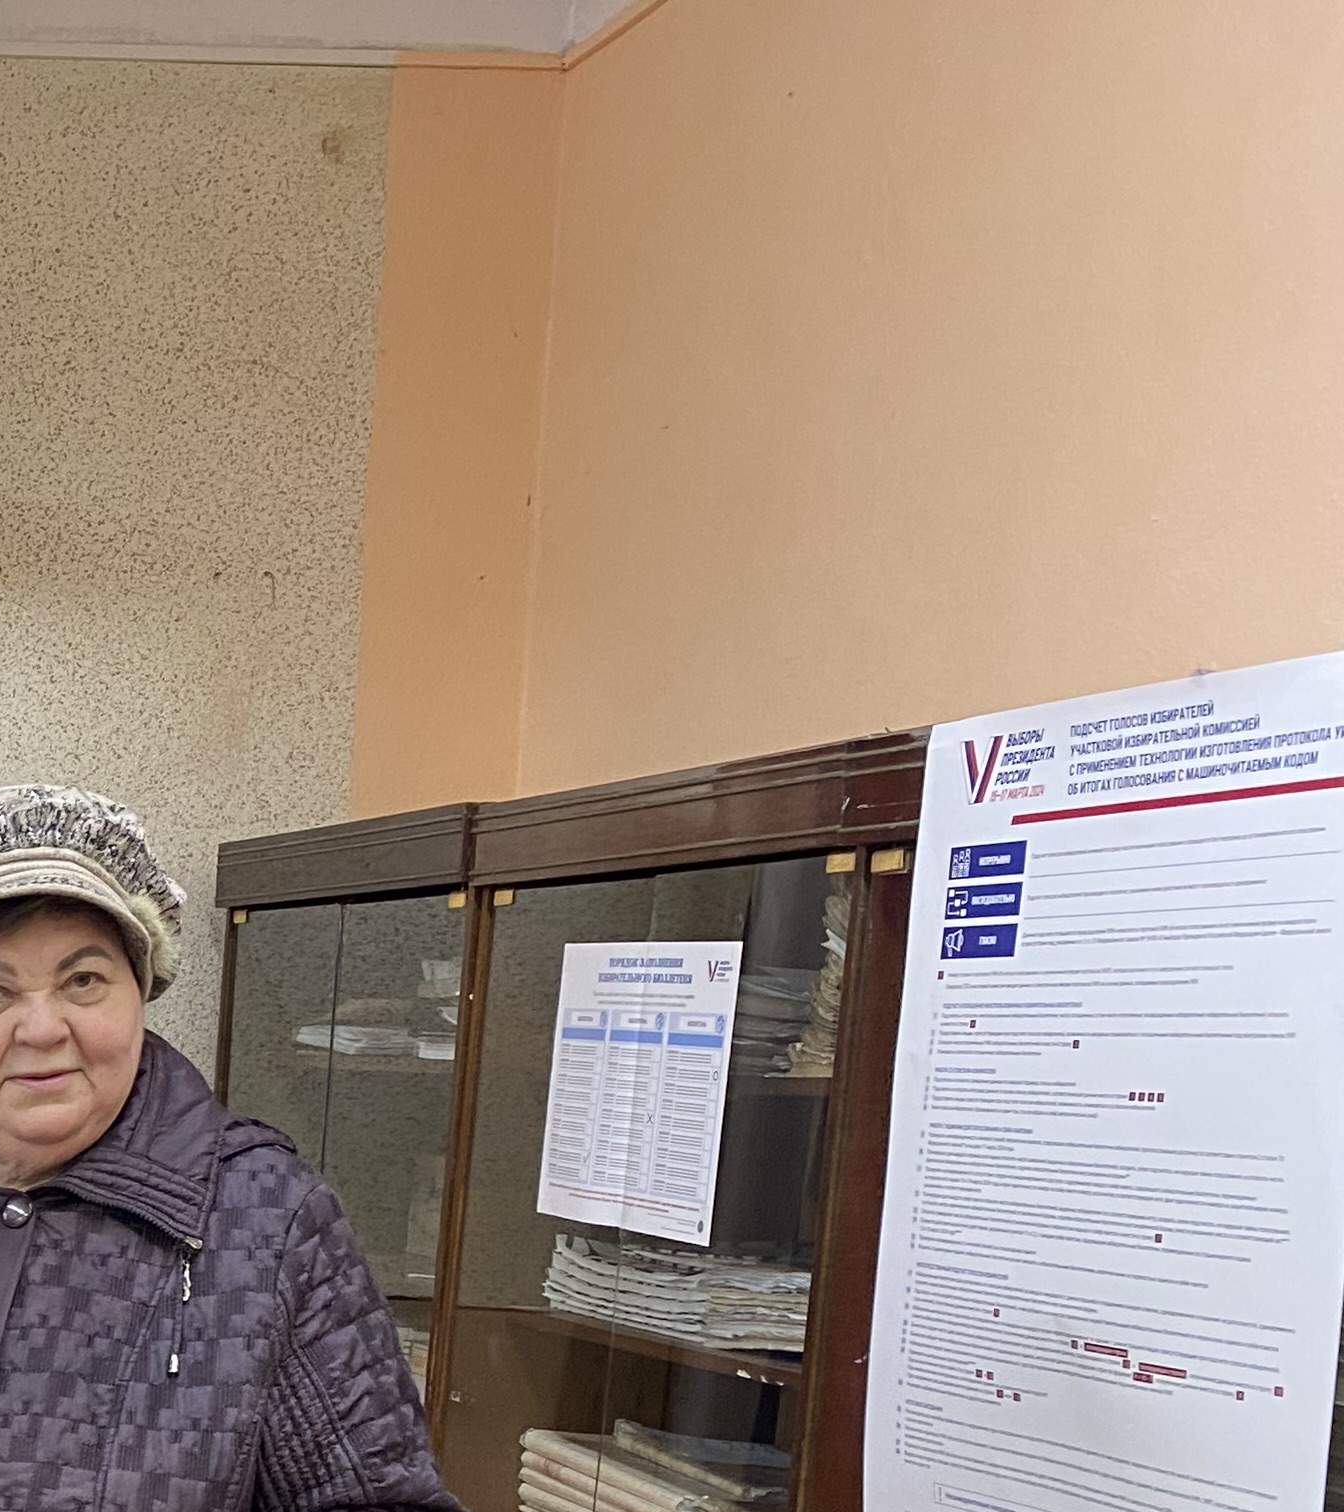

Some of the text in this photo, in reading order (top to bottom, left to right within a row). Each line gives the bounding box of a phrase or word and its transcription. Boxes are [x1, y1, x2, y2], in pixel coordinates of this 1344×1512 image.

[1006, 728, 1045, 748] ВЫБОРЫ
[1069, 700, 1215, 738] ПОДСЧЕТ ГОЛОСОВ ИЗБИРАТЕЛЕЙ
[1070, 714, 1261, 757] УЧАСТКОВОЙ ИЗБИРАТЕЛЬНОЙ КОМИССИЕЙ
[1000, 746, 1056, 767] ПРЕЗИДЕНТА
[1076, 755, 1137, 776] ПРИМЕНЕНИЕМ
[1139, 747, 1198, 767] ТЕХНОЛОГИИ
[1199, 736, 1272, 758] ИЗГОТОВЛЕНИЯ
[1273, 727, 1331, 748] ПРОТОКОЛА
[994, 768, 1031, 786] РОССИИ
[1068, 781, 1078, 796] ОБ
[1080, 778, 1112, 794] ИТОГАХ
[1113, 770, 1175, 791] ГОЛОСОВАНИЯ
[1186, 756, 1282, 780] МАШИНОЧИТАЕМЫМ
[1283, 751, 1319, 769] КОДОМ
